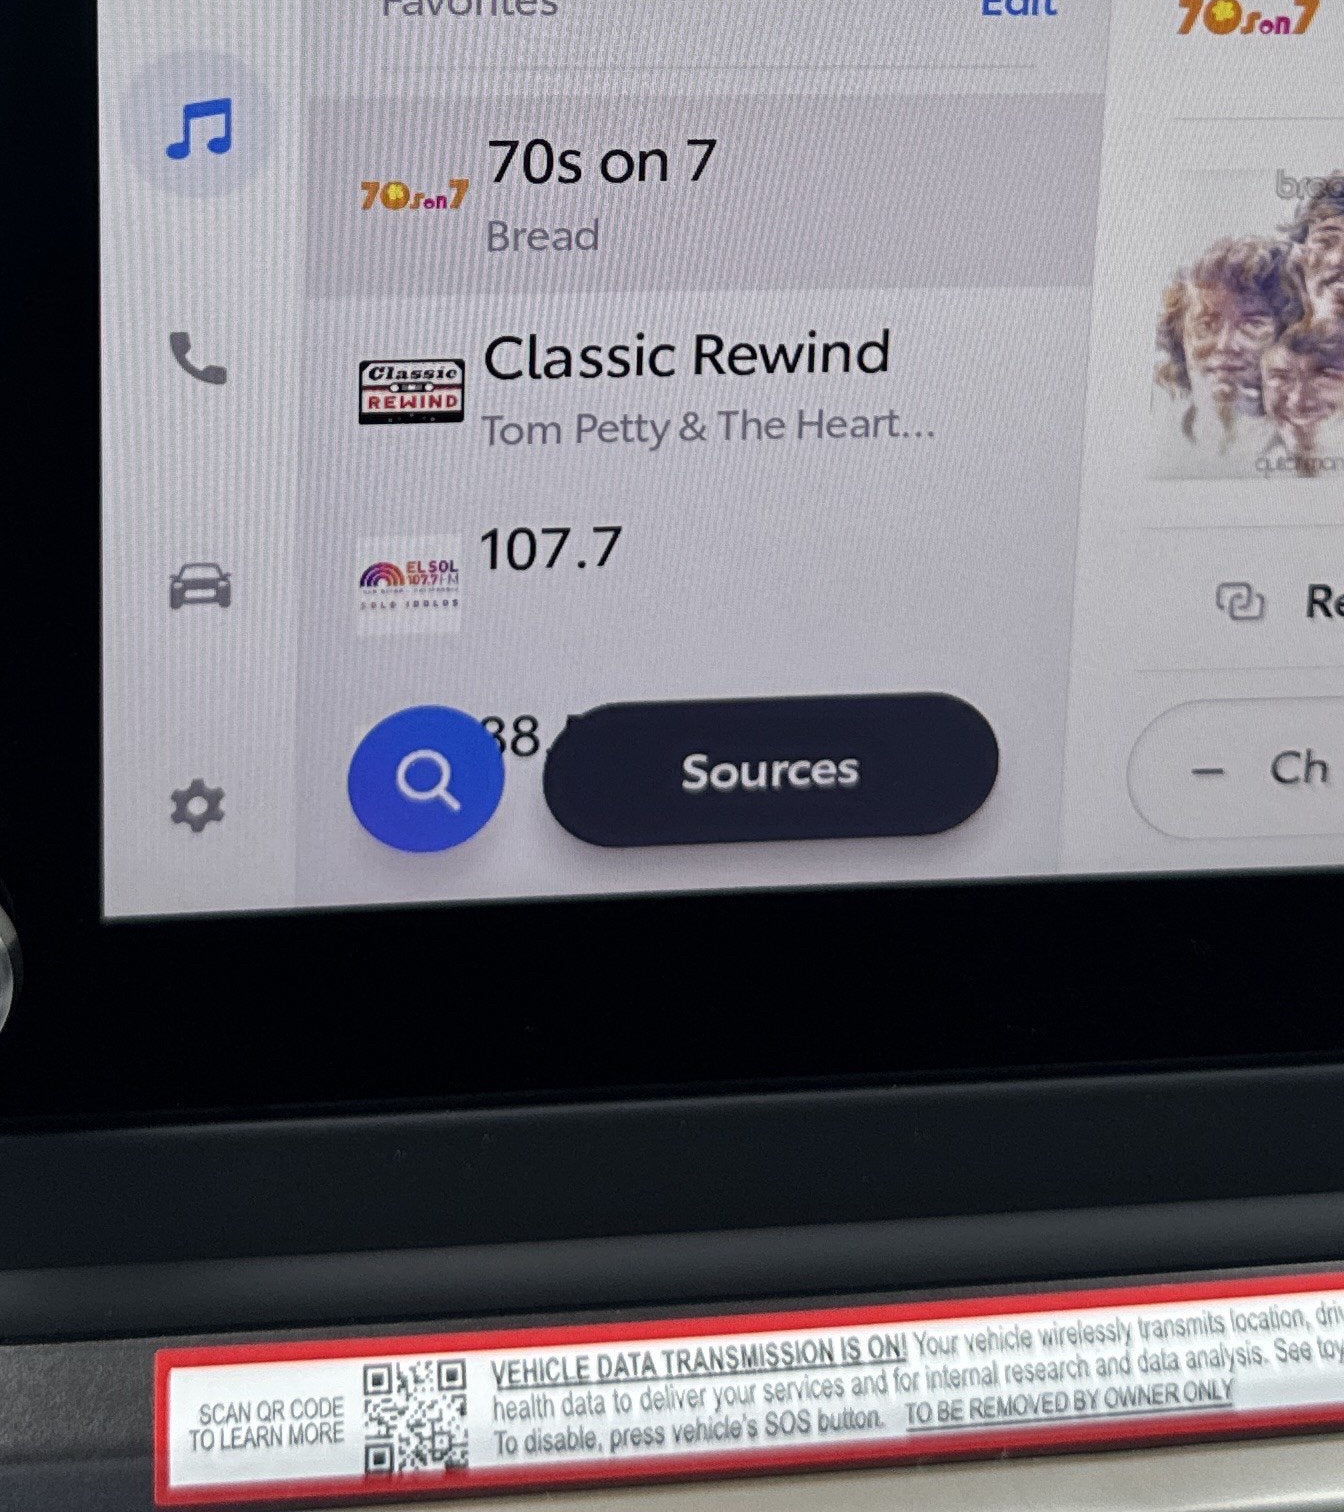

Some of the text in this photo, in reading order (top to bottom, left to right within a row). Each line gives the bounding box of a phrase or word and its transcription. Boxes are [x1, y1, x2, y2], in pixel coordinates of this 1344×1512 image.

[487, 138, 718, 184] 70s on 7
[487, 219, 600, 252] Bread
[368, 366, 457, 381] Classic
[484, 329, 891, 380] Classic Rewind
[367, 394, 458, 409] REWIND
[482, 414, 561, 448] Tom
[575, 411, 670, 451] Petty
[679, 411, 708, 443] &
[718, 409, 786, 441] The
[480, 525, 623, 571] 107.7
[681, 752, 859, 792] Sources
[1270, 748, 1329, 787] Ch
[491, 1355, 590, 1386] VEHICLE
[597, 1351, 656, 1380] DATA
[661, 1338, 834, 1375] TRANSMISSION
[841, 1336, 861, 1362] IS
[868, 1332, 906, 1359] ON!
[913, 1331, 957, 1357] Your
[964, 1324, 1033, 1352] vehicle
[1038, 1316, 1132, 1347] wirelessly
[1137, 1310, 1225, 1339] transmits
[1230, 1304, 1310, 1333] location,
[493, 1392, 555, 1421] health
[561, 1390, 606, 1417] data
[612, 1389, 633, 1414] to
[639, 1385, 706, 1412] deliver
[712, 1384, 756, 1412] your
[763, 1374, 845, 1403] services
[851, 1368, 887, 1396] and
[892, 1366, 920, 1393] for
[925, 1359, 998, 1389] internal
[1004, 1353, 1090, 1384] research
[1095, 1349, 1131, 1376] and
[1137, 1347, 1180, 1373] data
[1185, 1339, 1269, 1373] analysis.
[1273, 1337, 1313, 1363] See
[199, 1396, 345, 1425] SCAN QR CODE
[494, 1378, 1234, 1455] To disable, press vehicle's SOS button. TO BE REMOVED BY OWNER ONLY
[189, 1421, 345, 1452] TO LEARN MORE
